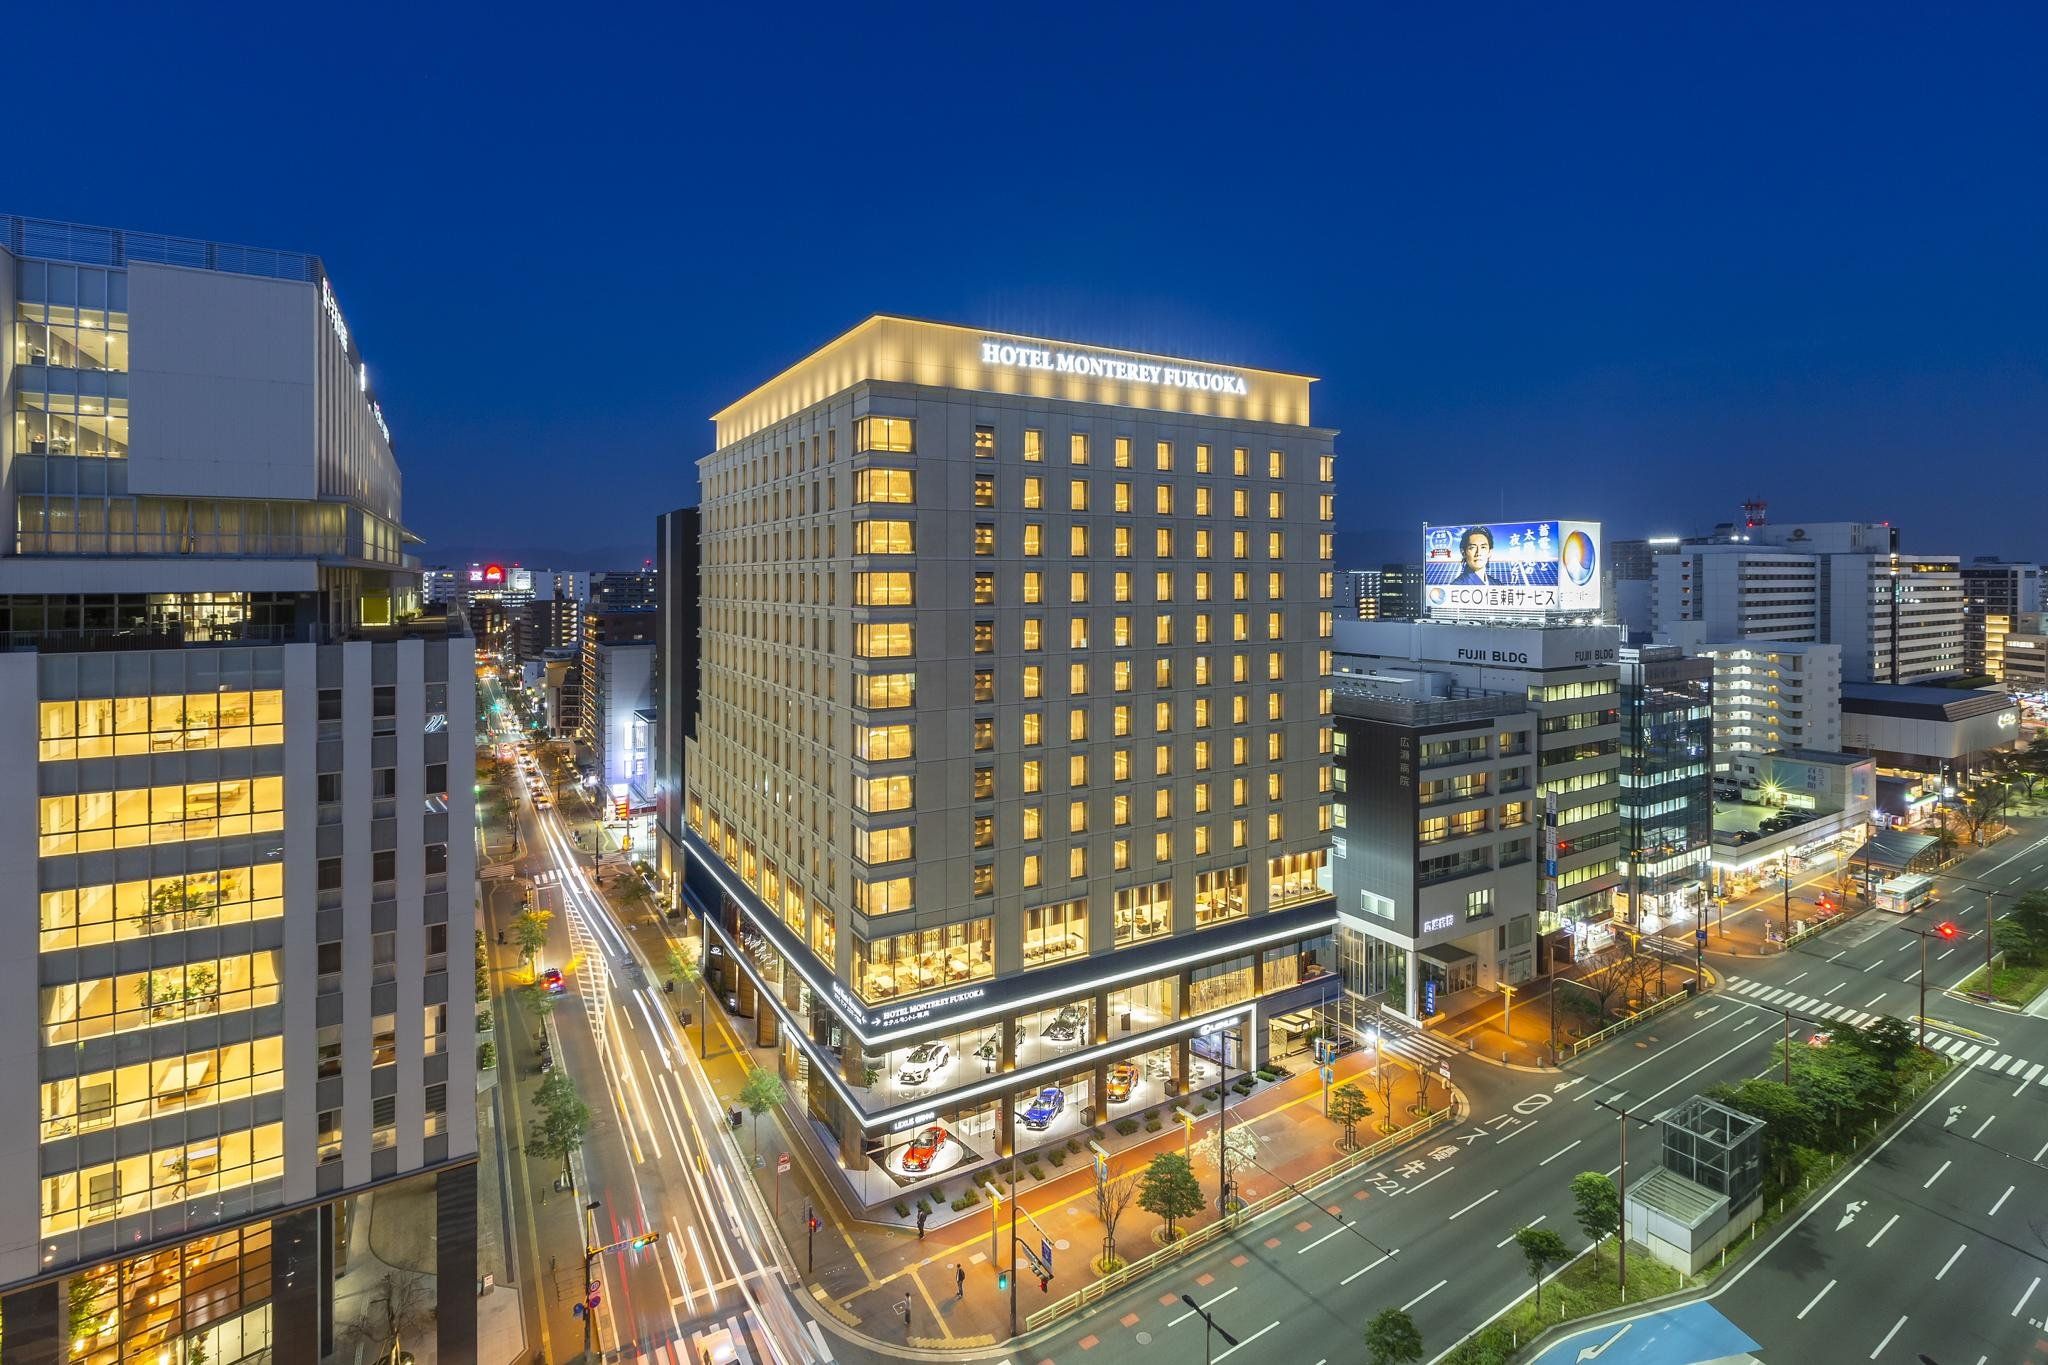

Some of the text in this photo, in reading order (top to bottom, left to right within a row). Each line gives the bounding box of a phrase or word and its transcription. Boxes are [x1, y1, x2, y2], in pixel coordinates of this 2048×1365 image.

[982, 342, 1247, 395] HOTEL MONTEREY FUKUOKA
[1451, 588, 1555, 606] ECO信頼サービス
[1458, 648, 1528, 664] FUJII BLDG
[1574, 648, 1614, 662] FUJII BLDG
[883, 989, 985, 1020] HOTEL MONTEREY FUKUOKA
[1364, 1172, 1406, 1197] 7-21
